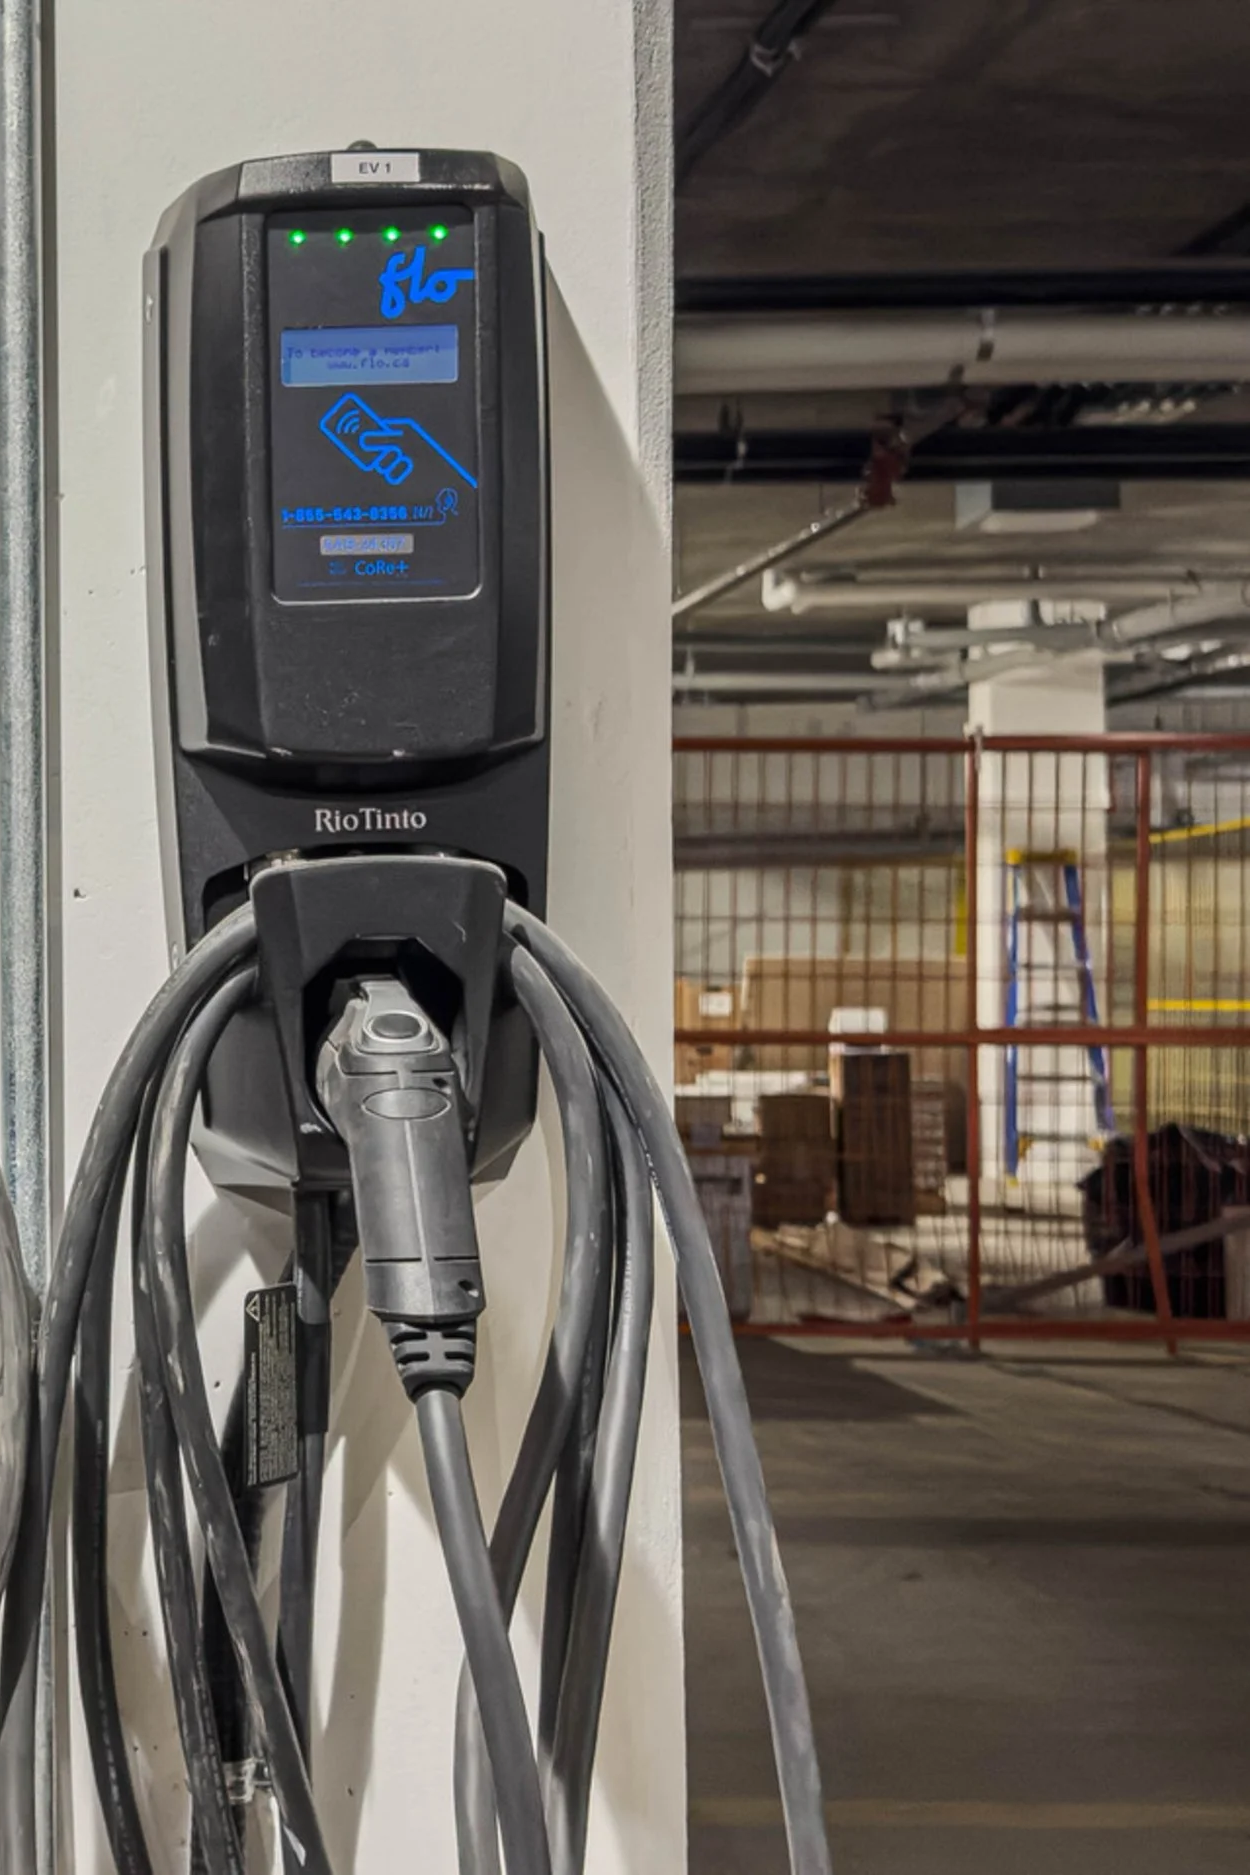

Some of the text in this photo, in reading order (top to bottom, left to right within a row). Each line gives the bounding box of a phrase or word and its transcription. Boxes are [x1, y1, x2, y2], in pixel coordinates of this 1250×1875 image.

[358, 162, 392, 174] EV 1
[378, 245, 476, 319] flo
